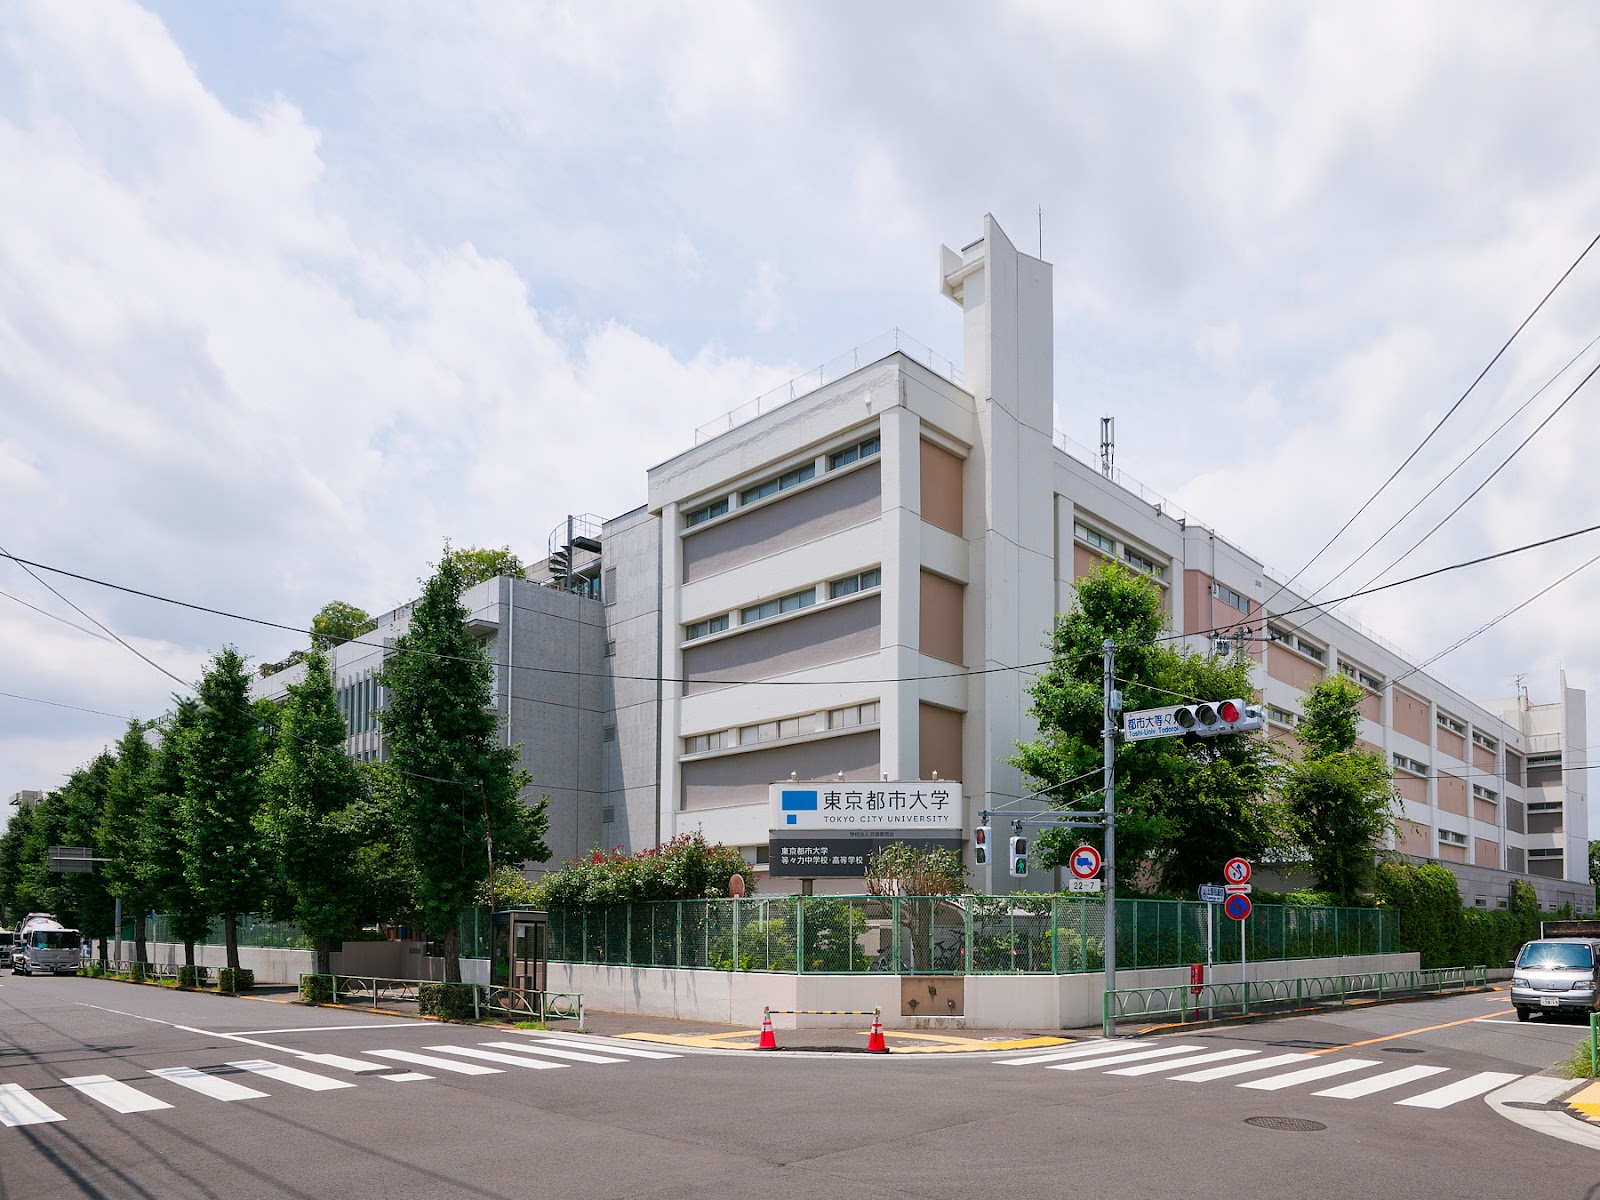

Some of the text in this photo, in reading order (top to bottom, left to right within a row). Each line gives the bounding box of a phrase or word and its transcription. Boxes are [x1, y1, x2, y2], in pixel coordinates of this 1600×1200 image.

[1128, 714, 1177, 730] 都市大等々
[823, 790, 950, 811] 東京都市大学
[824, 815, 949, 823] TOKYO CITY UNIVERSITY
[781, 847, 829, 855] 東京都市大学
[1074, 881, 1094, 889] 22-7
